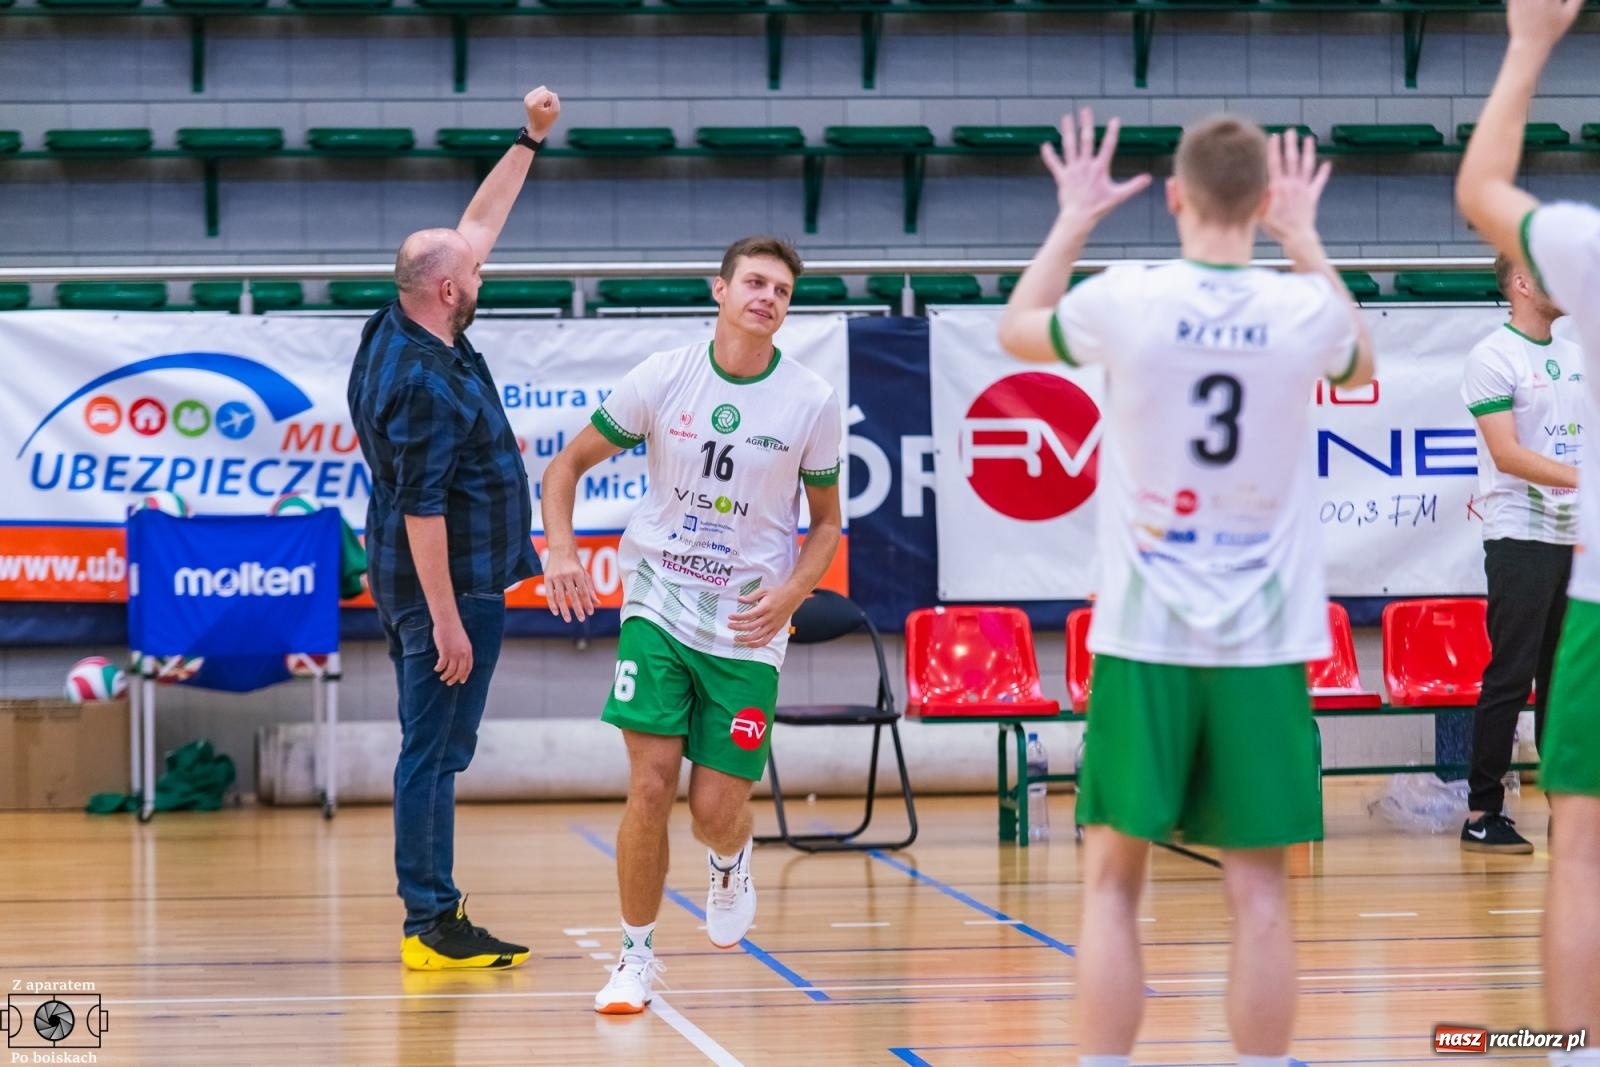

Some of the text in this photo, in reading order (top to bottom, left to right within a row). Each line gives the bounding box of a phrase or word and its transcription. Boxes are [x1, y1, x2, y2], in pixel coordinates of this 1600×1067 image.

[503, 384, 588, 409] Biura
[1189, 372, 1243, 467] 3
[700, 440, 735, 482] 16
[745, 437, 790, 453] AGROTEAM
[960, 417, 1102, 478] RV
[1317, 428, 1478, 477] NE
[674, 487, 749, 516] VISON
[1388, 493, 1437, 527] FM
[174, 562, 315, 597] molten
[730, 717, 767, 740] RV
